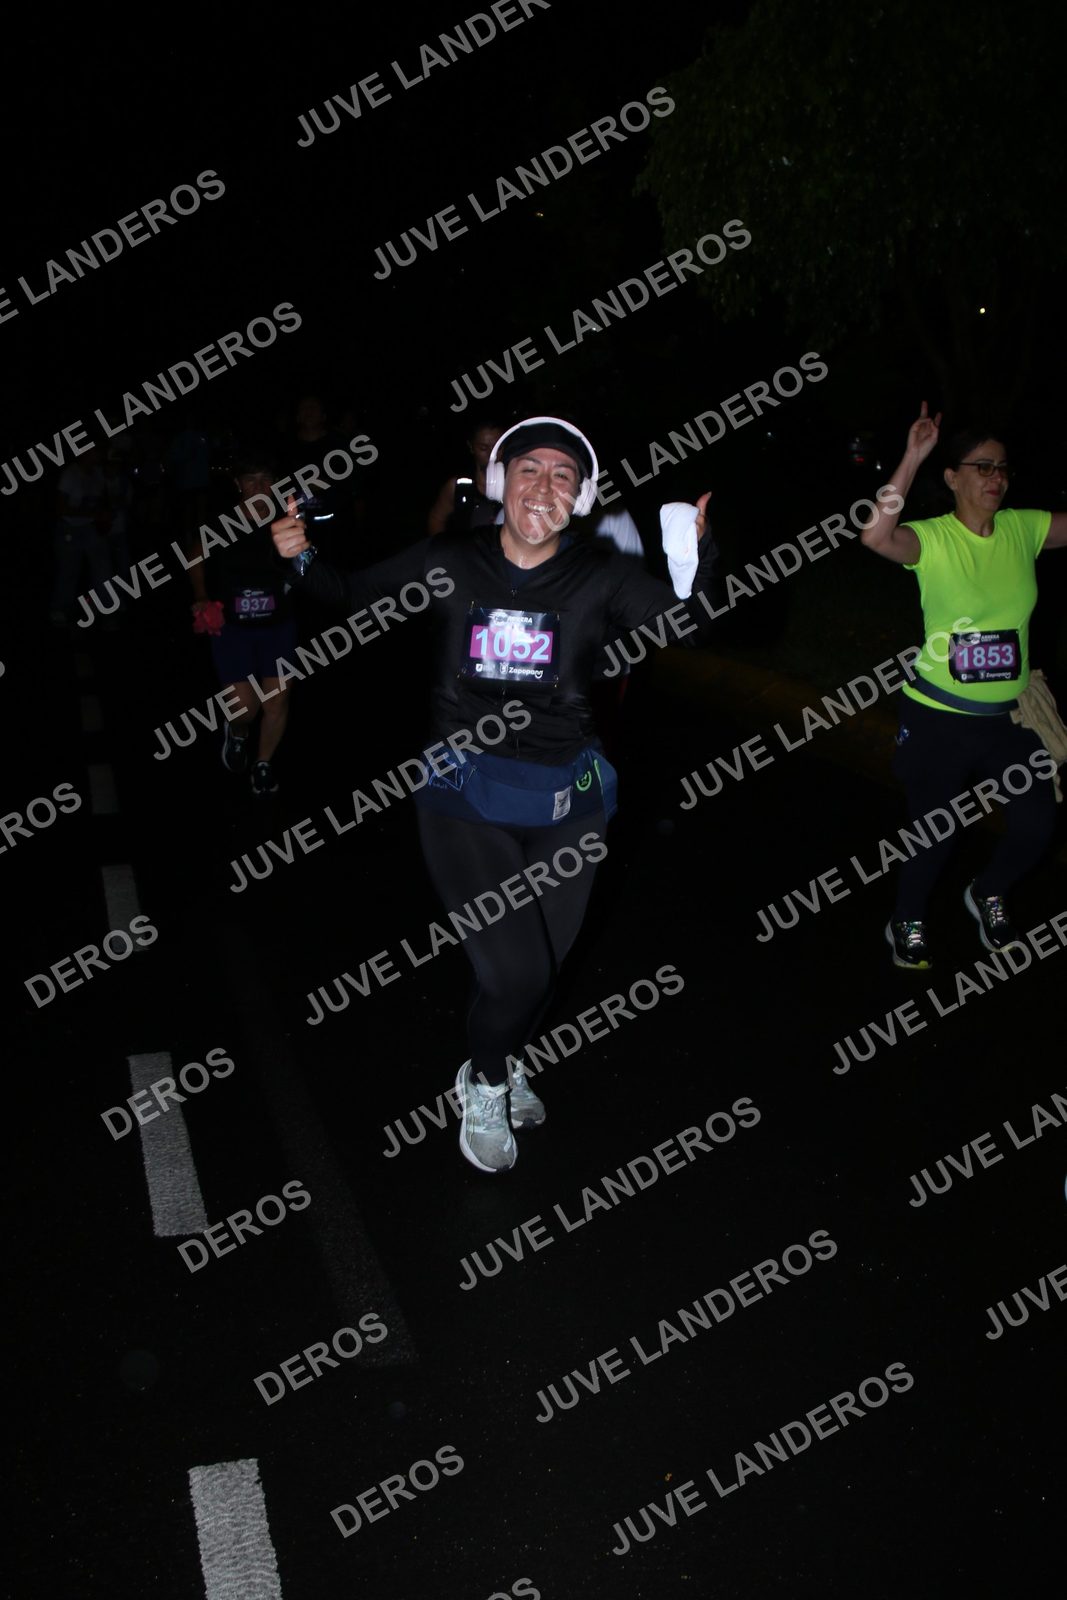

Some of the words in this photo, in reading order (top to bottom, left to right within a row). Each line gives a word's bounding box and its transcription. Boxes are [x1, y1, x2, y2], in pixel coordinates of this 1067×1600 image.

[241, 597, 269, 612] 937
[476, 628, 551, 661] 1052
[958, 645, 1014, 668] 1853
